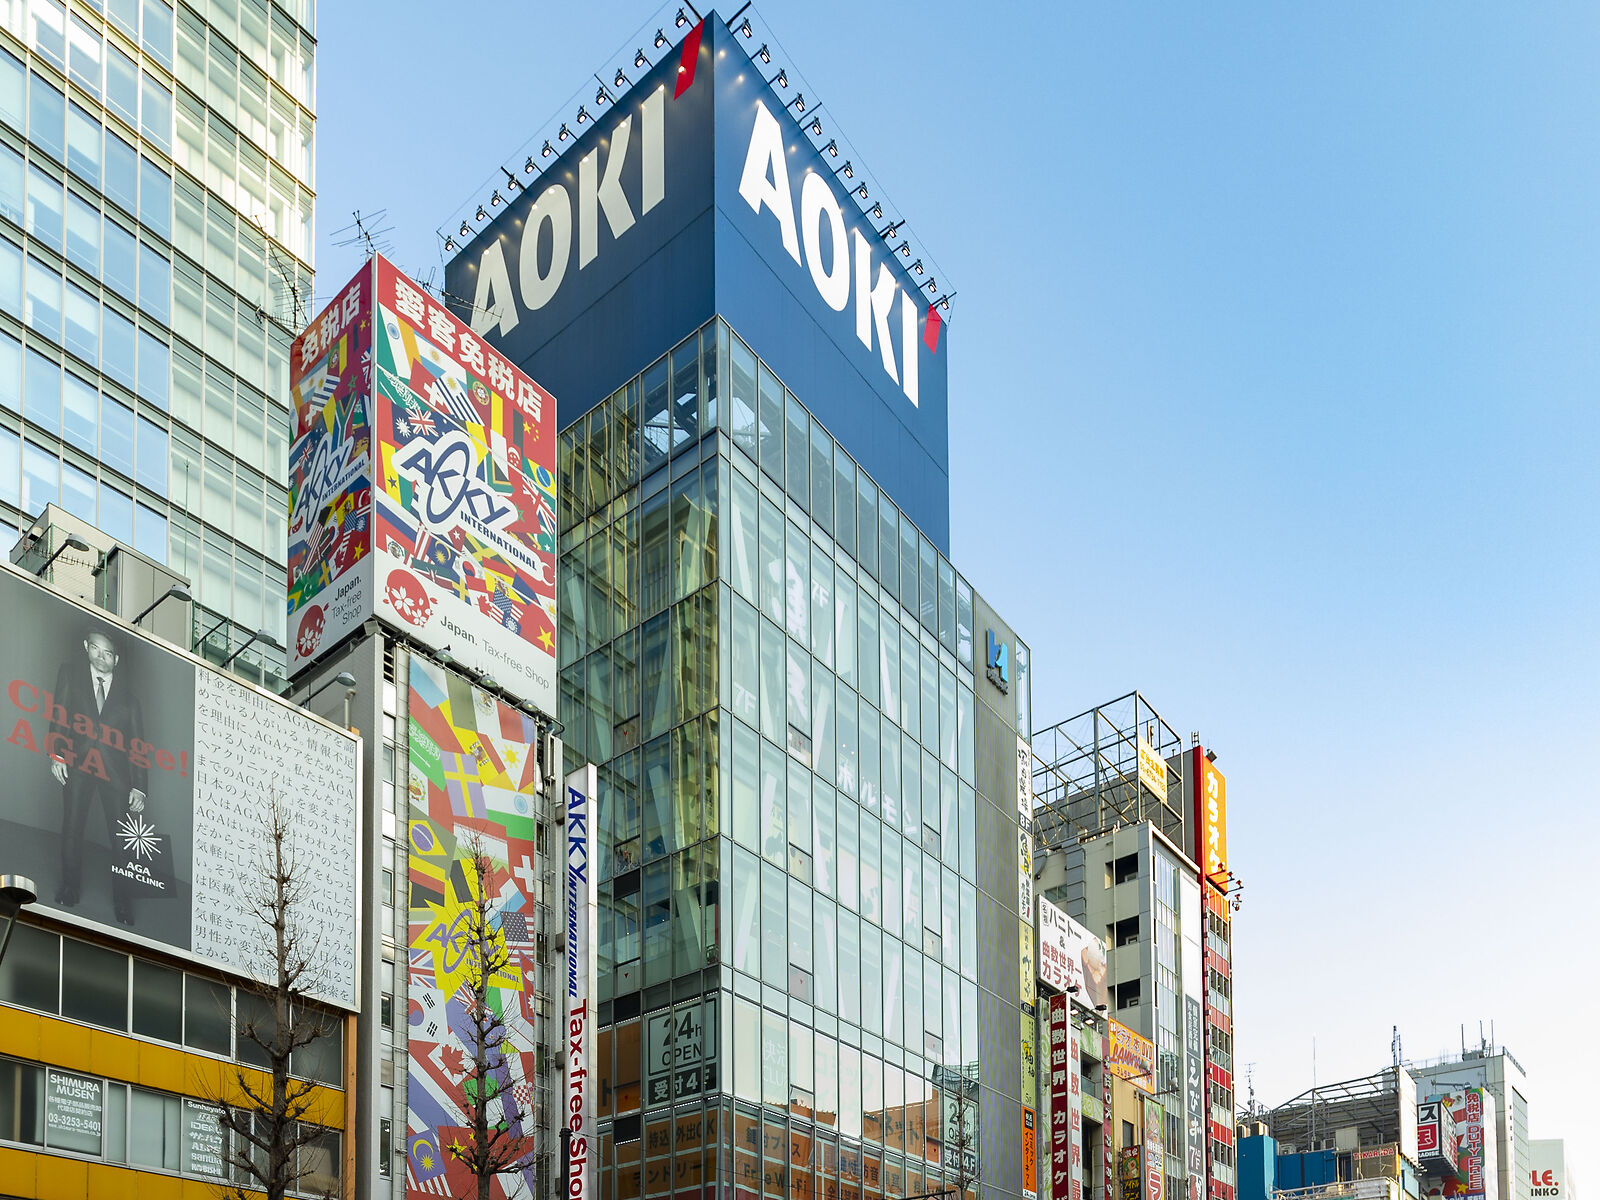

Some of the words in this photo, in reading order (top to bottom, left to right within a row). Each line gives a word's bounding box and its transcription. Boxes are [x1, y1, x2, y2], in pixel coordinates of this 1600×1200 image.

[472, 84, 665, 337] AOKI
[738, 99, 919, 408] AOKI
[300, 282, 362, 372] 免税店
[395, 276, 542, 424] 愛客免税店
[321, 461, 366, 500] INTERNATIONAL
[460, 512, 537, 571] INTERNATIONAL
[334, 575, 362, 601] Japan.
[331, 590, 362, 621] Tax-free
[342, 603, 362, 626] Shop
[440, 615, 478, 647] Japan.
[482, 638, 523, 674] Tax-free
[524, 665, 550, 690] Shop
[7, 679, 188, 779] Change!
[6, 718, 111, 782] AGA
[567, 785, 587, 884] AKKY
[1019, 815, 1031, 831] 8F
[1207, 770, 1223, 874] カラオケ
[111, 864, 136, 881] HAIR
[136, 873, 165, 890] CLINIC
[126, 861, 151, 877] AGA
[568, 866, 577, 998] INTERNATIONAL
[1049, 908, 1082, 940] ハニトー
[1042, 940, 1082, 975] 曲数世界一
[1060, 935, 1066, 950] &
[1042, 959, 1083, 998] カラオケ
[663, 1011, 703, 1047] 24h
[569, 999, 587, 1132] Tax-free
[661, 1043, 703, 1067] OPEN
[1051, 1007, 1067, 1099] 曲数世界一
[50, 1073, 100, 1093] SHIMURA
[56, 1085, 95, 1101] MUSEN
[48, 1112, 101, 1132] 03-3253-5401
[187, 1100, 226, 1115] Sunhayato
[1466, 1092, 1481, 1123] 免税店
[1053, 1110, 1068, 1185] カラオケ
[1467, 1125, 1482, 1157] DUTY
[1467, 1157, 1483, 1190] FREE
[1529, 1169, 1559, 1187] LE.
[1124, 1191, 1140, 1200] アニメ
